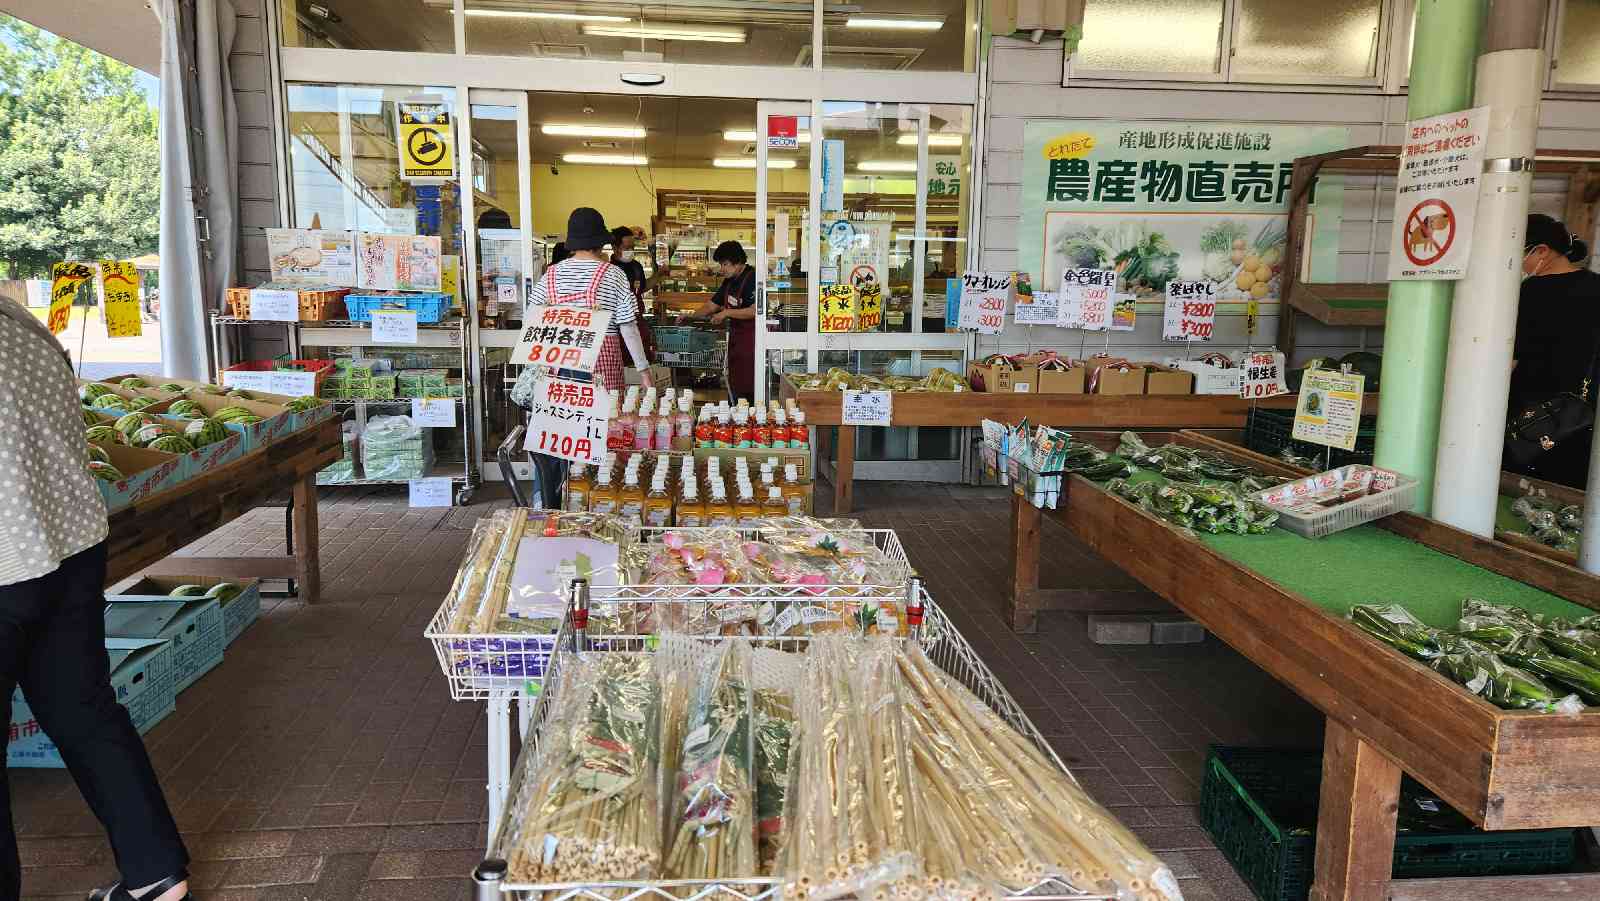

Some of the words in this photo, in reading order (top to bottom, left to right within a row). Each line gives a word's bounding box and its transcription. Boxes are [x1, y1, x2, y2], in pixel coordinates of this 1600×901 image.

[1048, 137, 1093, 158] とれたて
[1119, 130, 1272, 151] 産地形成促進施設
[935, 161, 956, 176] 安心
[542, 307, 591, 327] 特売品
[1183, 301, 1215, 317] ¥2800
[523, 326, 596, 349] 飲料各種
[1181, 319, 1213, 337] ¥3000
[528, 344, 582, 367] 80円
[547, 382, 594, 408] 特売品
[534, 403, 606, 423] ジャスミンティー
[586, 425, 602, 439] 1L
[540, 431, 592, 460] 120円
